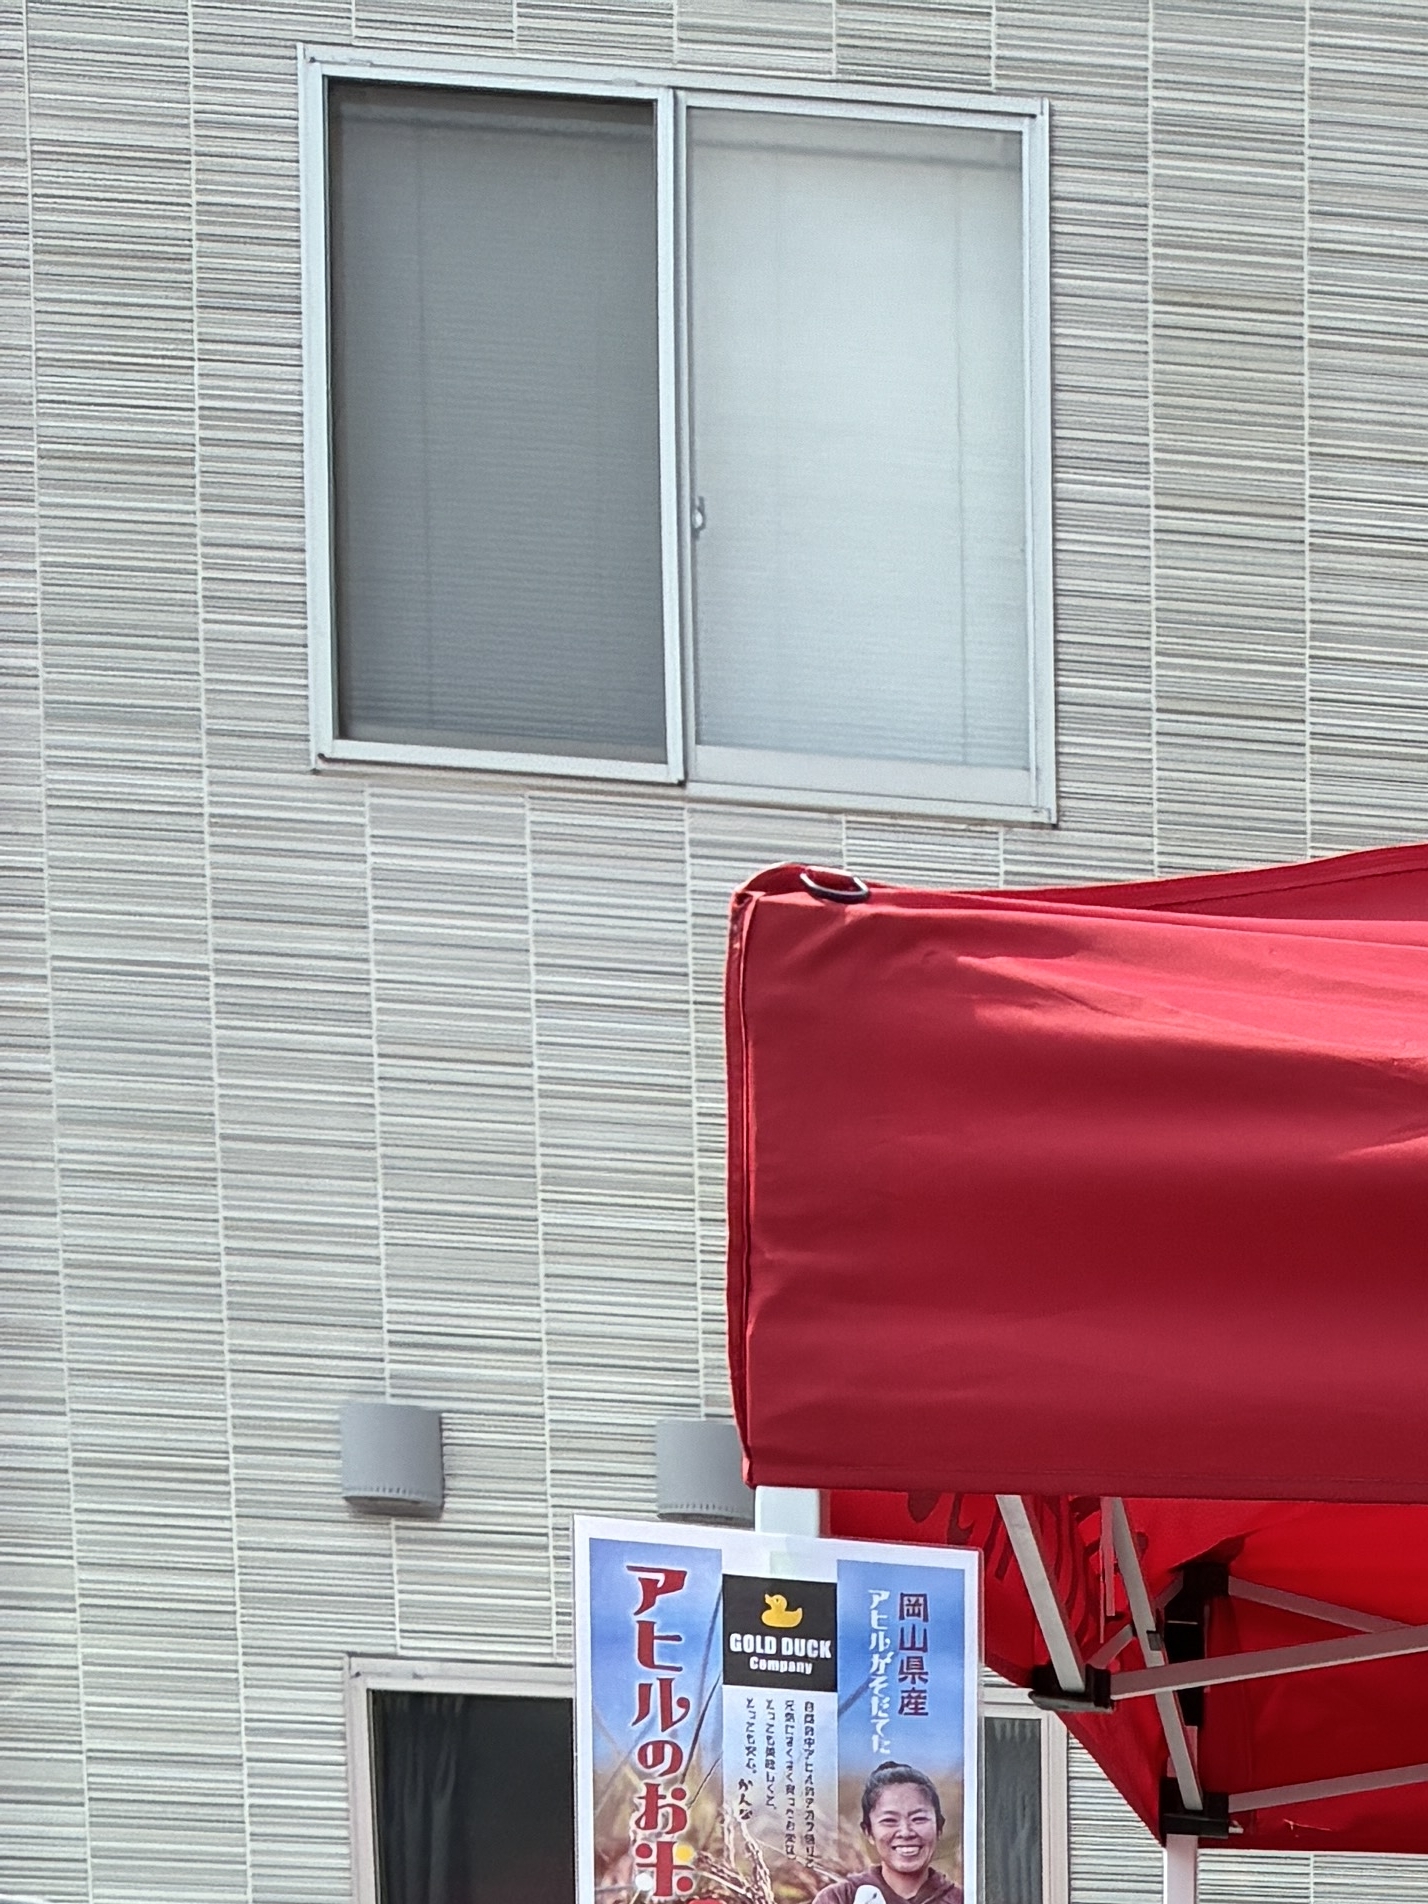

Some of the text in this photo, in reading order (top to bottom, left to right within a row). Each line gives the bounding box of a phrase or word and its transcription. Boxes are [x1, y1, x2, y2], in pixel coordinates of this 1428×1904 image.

[729, 1633, 833, 1659] GOLD DUCK
[748, 1656, 814, 1675] Company
[898, 1592, 930, 1718] 岡山県産
[625, 1564, 696, 1898] アヒルのお米
